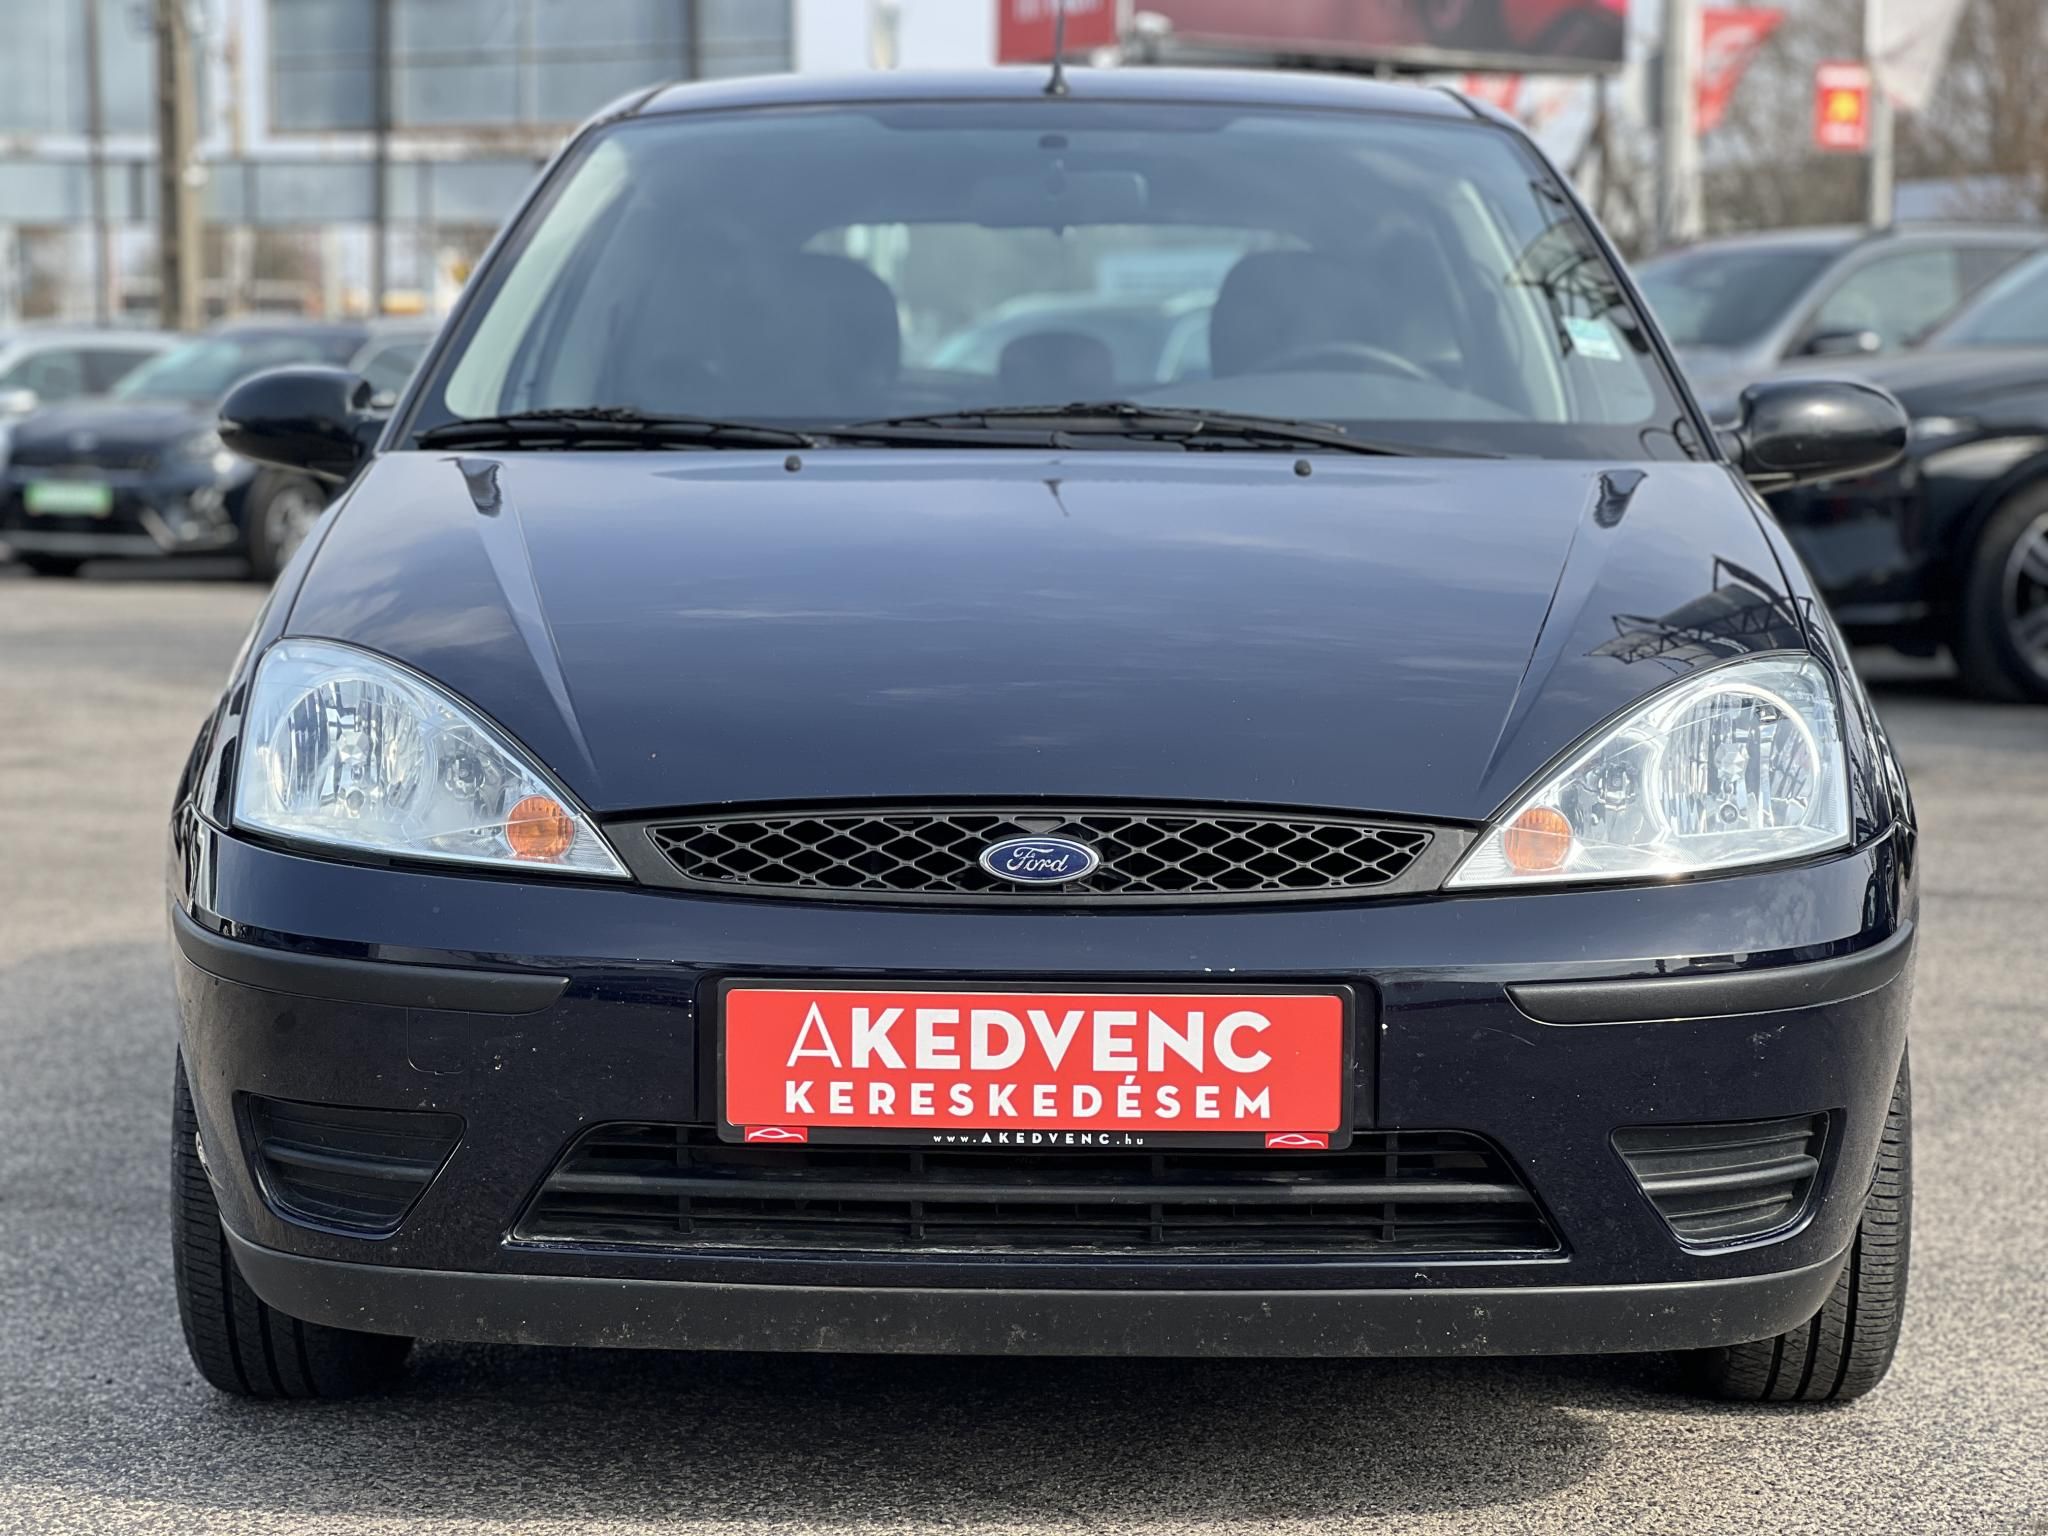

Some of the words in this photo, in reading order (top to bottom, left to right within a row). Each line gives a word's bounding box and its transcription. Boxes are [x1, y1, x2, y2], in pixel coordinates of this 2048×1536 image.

[1006, 846, 1069, 872] Ford
[786, 1001, 1272, 1073] AKEDVENC
[785, 1074, 1271, 1119] KERESKEDÉSEM
[933, 1131, 1144, 1145] www.AKEDVENC.hu
